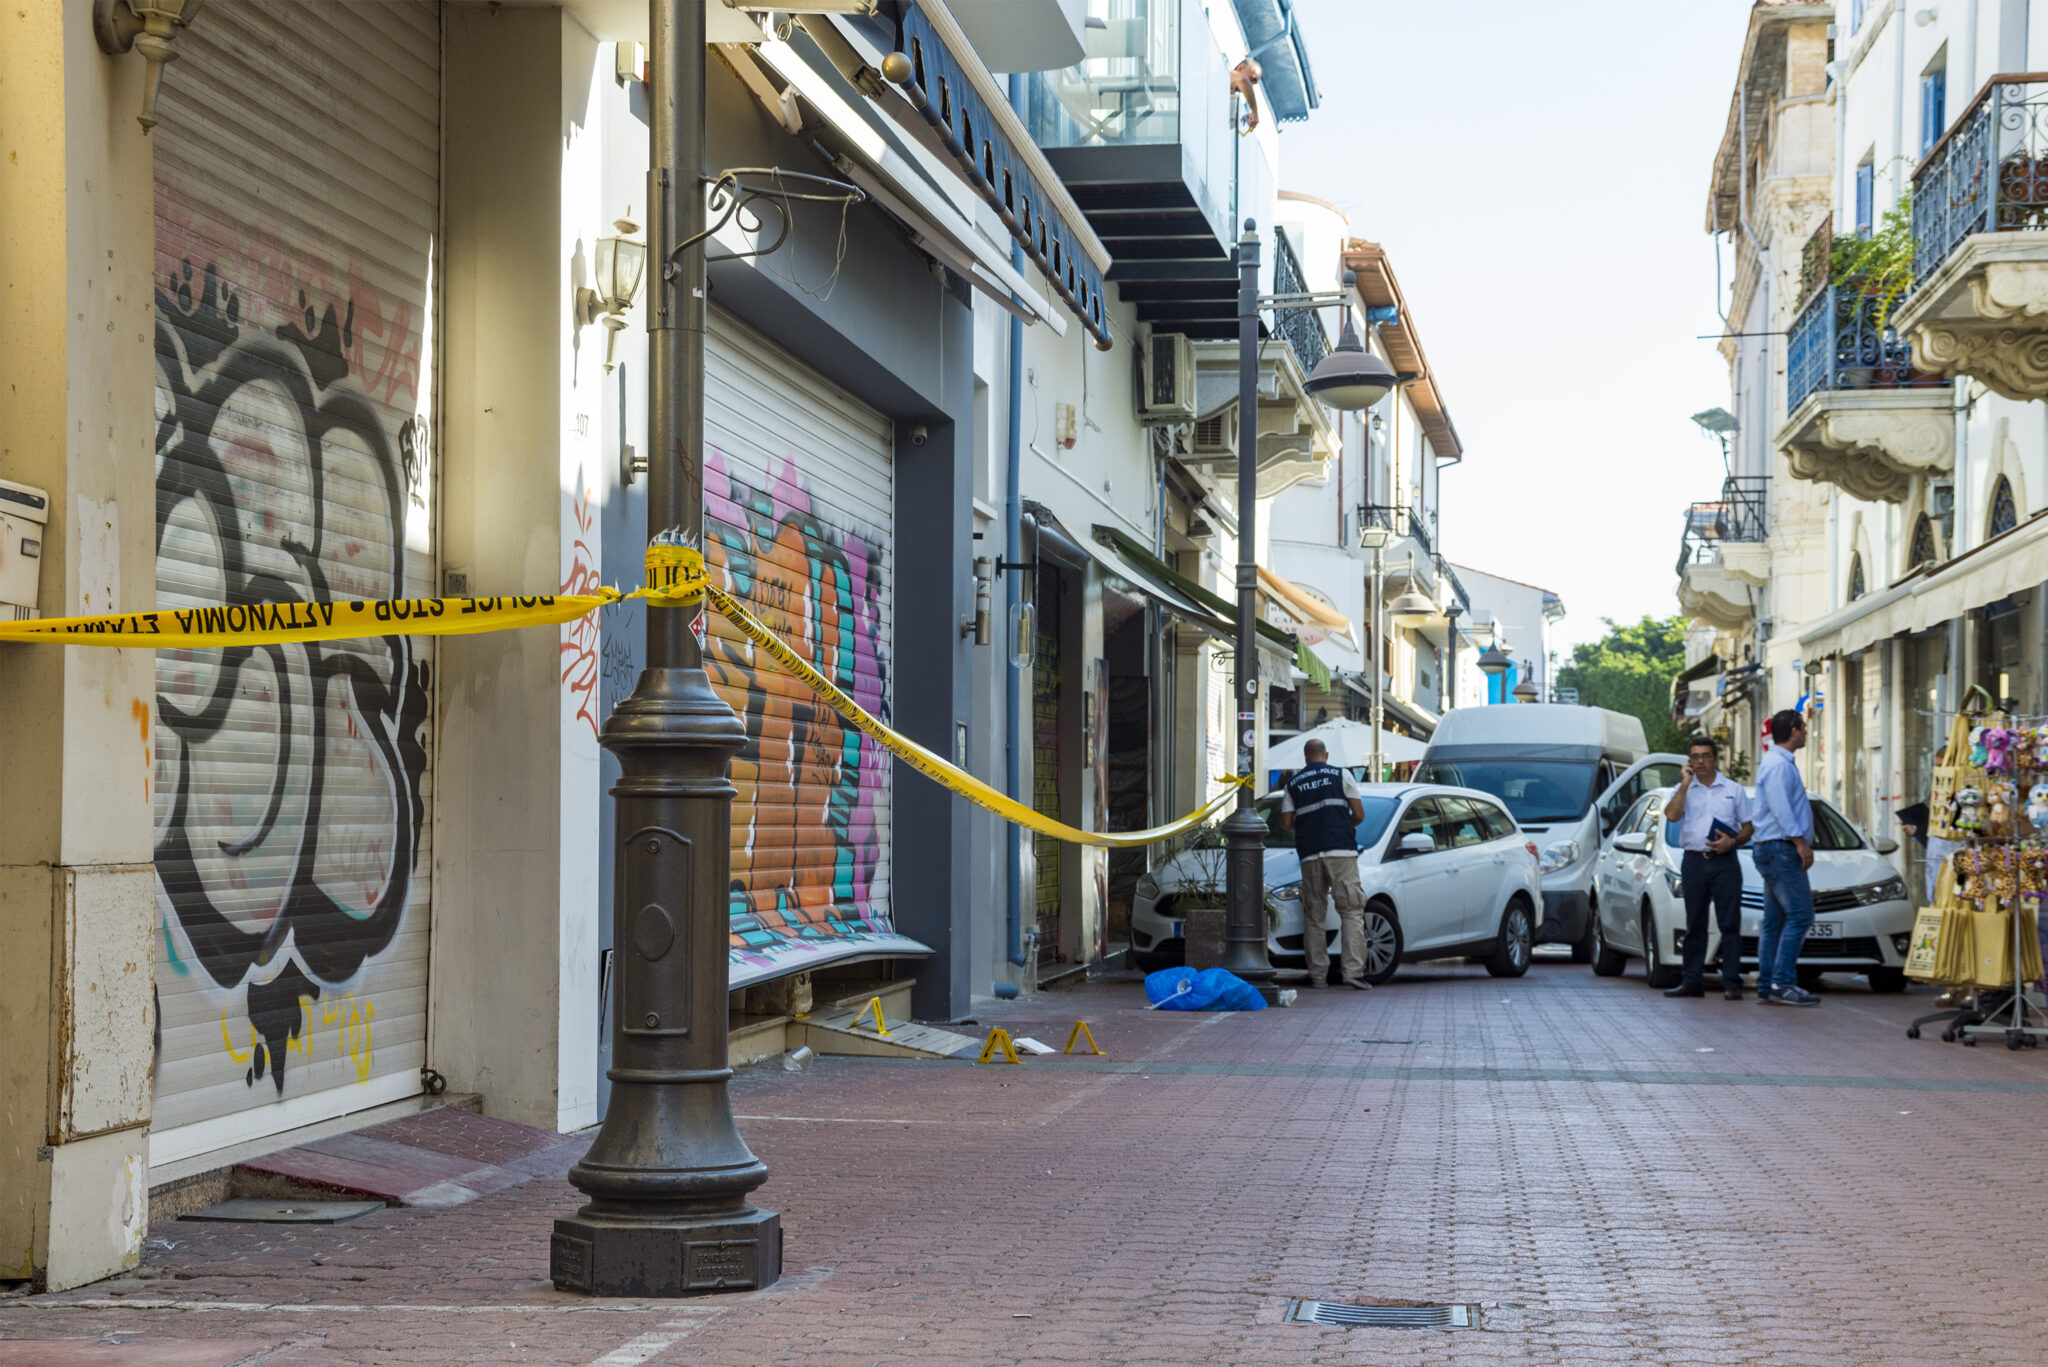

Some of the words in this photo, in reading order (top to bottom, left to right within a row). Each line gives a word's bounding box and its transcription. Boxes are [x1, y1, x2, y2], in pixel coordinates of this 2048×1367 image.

[174, 602, 334, 634] ΑΣΤΥΝΟΜΙΑ
[375, 598, 445, 621] STOP
[28, 613, 161, 634] ΣΤΑΜ
[1320, 768, 1340, 776] POLICE
